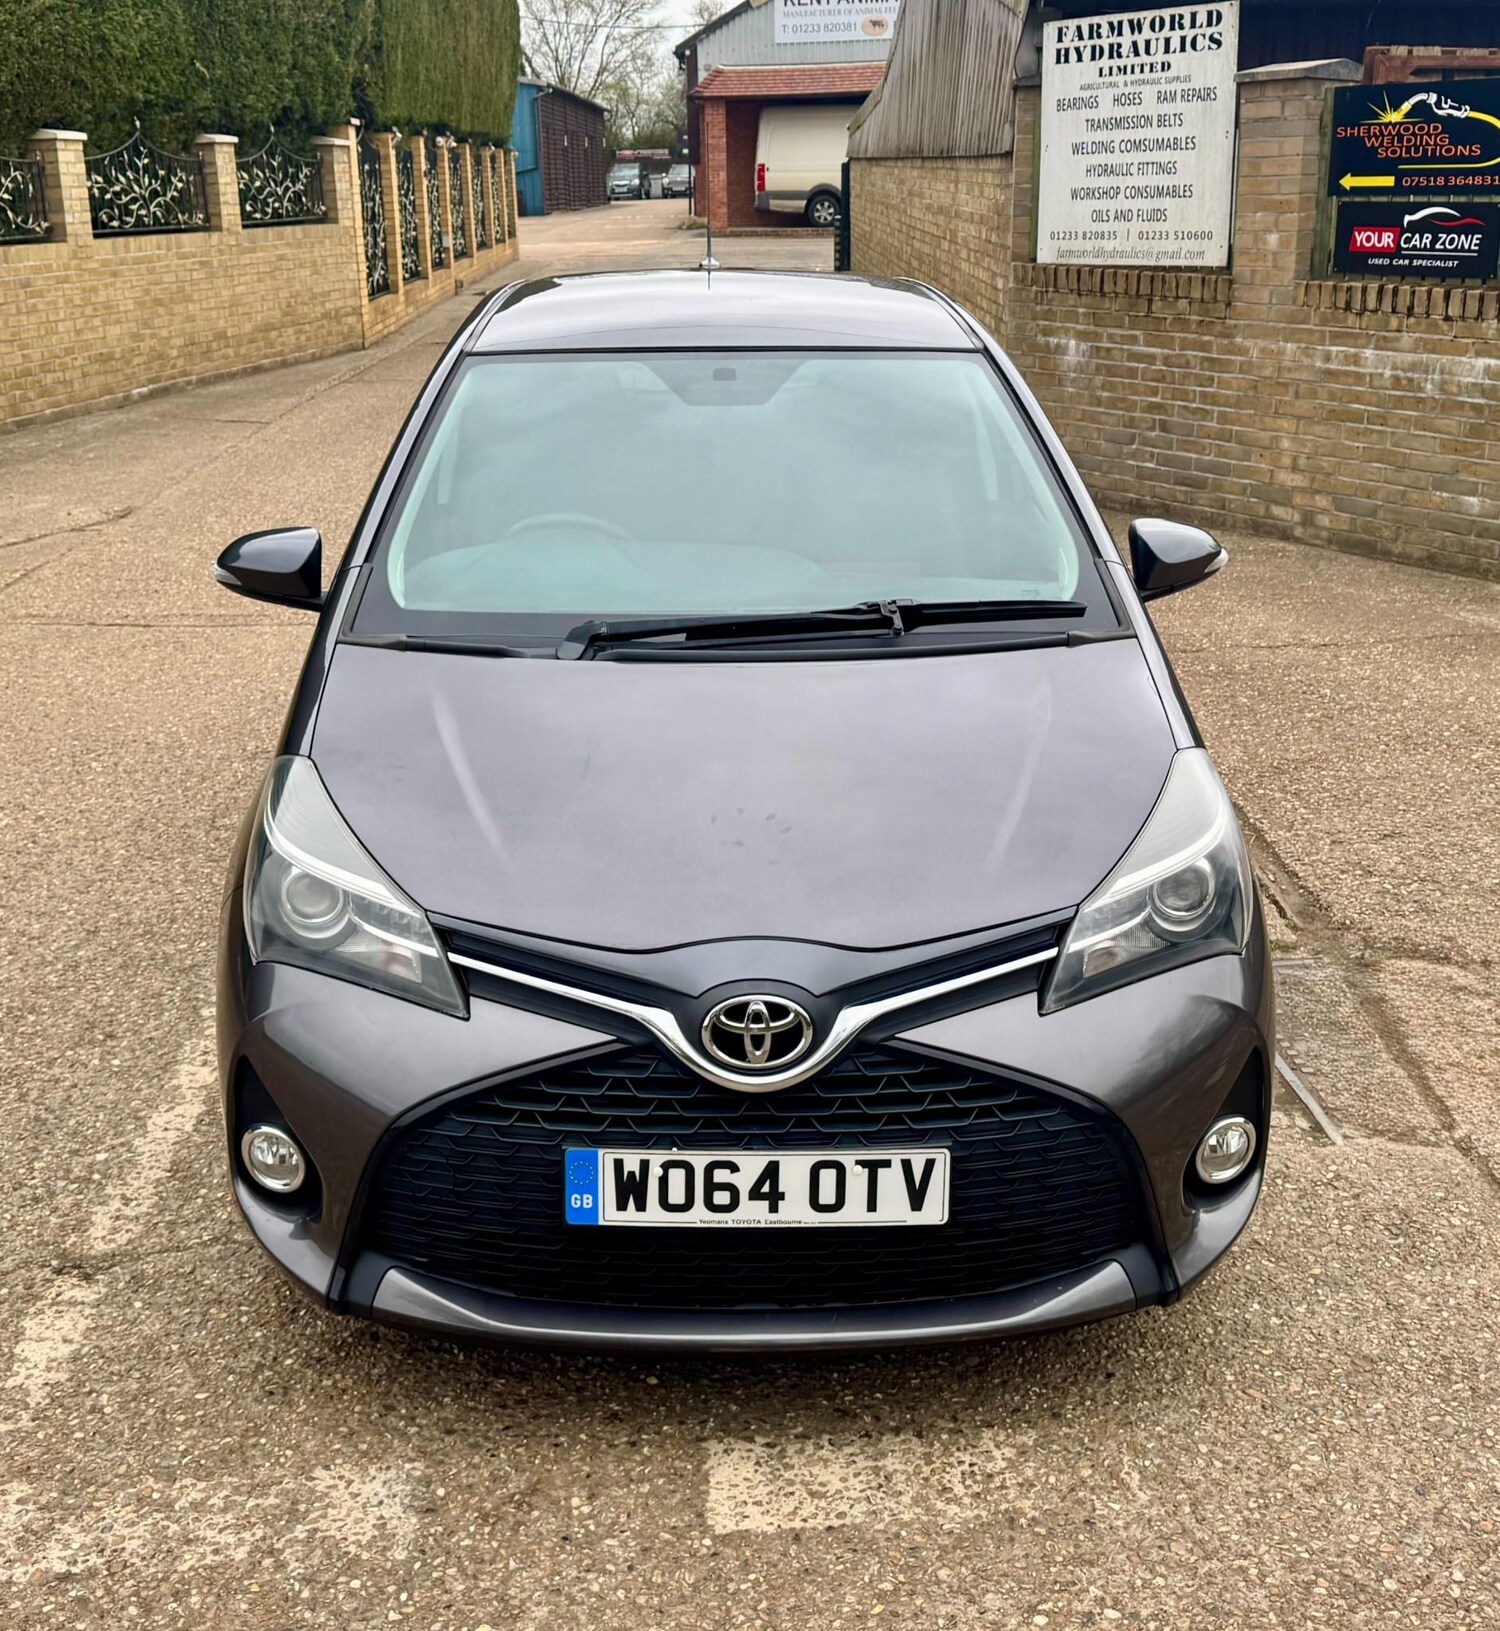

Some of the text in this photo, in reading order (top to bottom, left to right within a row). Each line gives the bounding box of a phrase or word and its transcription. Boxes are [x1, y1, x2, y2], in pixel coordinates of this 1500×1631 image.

[783, 8, 841, 18] MANUFACTURER
[843, 8, 854, 17] OF
[782, 22, 857, 34] T: 01233 820381
[1056, 9, 1223, 44] FARMWORLD
[1055, 31, 1223, 65] HYDRAULICS
[1098, 60, 1172, 78] LIMITED
[1079, 74, 1191, 92] AGRICULTURAL & HYDRAULIC SUPPLIES
[1056, 86, 1217, 112] BEARINGS HOSES RAM REPAIRS
[1085, 112, 1183, 133] TRANSMISSION BELTS
[1336, 123, 1442, 138] SHERWOOD
[1072, 139, 1115, 156] WELDING
[1364, 134, 1449, 147] WELDING
[1377, 144, 1481, 158] SOLUTIONS
[1085, 160, 1178, 178] HYDRAULIC FITTINGS
[1402, 175, 1500, 187] 07518 364831
[1070, 184, 1193, 201] WORKSHOP CONSUMABLES
[1091, 208, 1168, 223] OILS AND FLUIDS
[1050, 230, 1213, 241] 01233 820835 01233 510600
[1354, 231, 1482, 250] YOUR CAR ZONE
[1056, 246, 1205, 263] farmworldhydraulics@gmail.com
[1368, 258, 1459, 268] USED CAR SPECIALIST
[809, 1158, 936, 1213] OTV
[570, 1193, 593, 1208] GB
